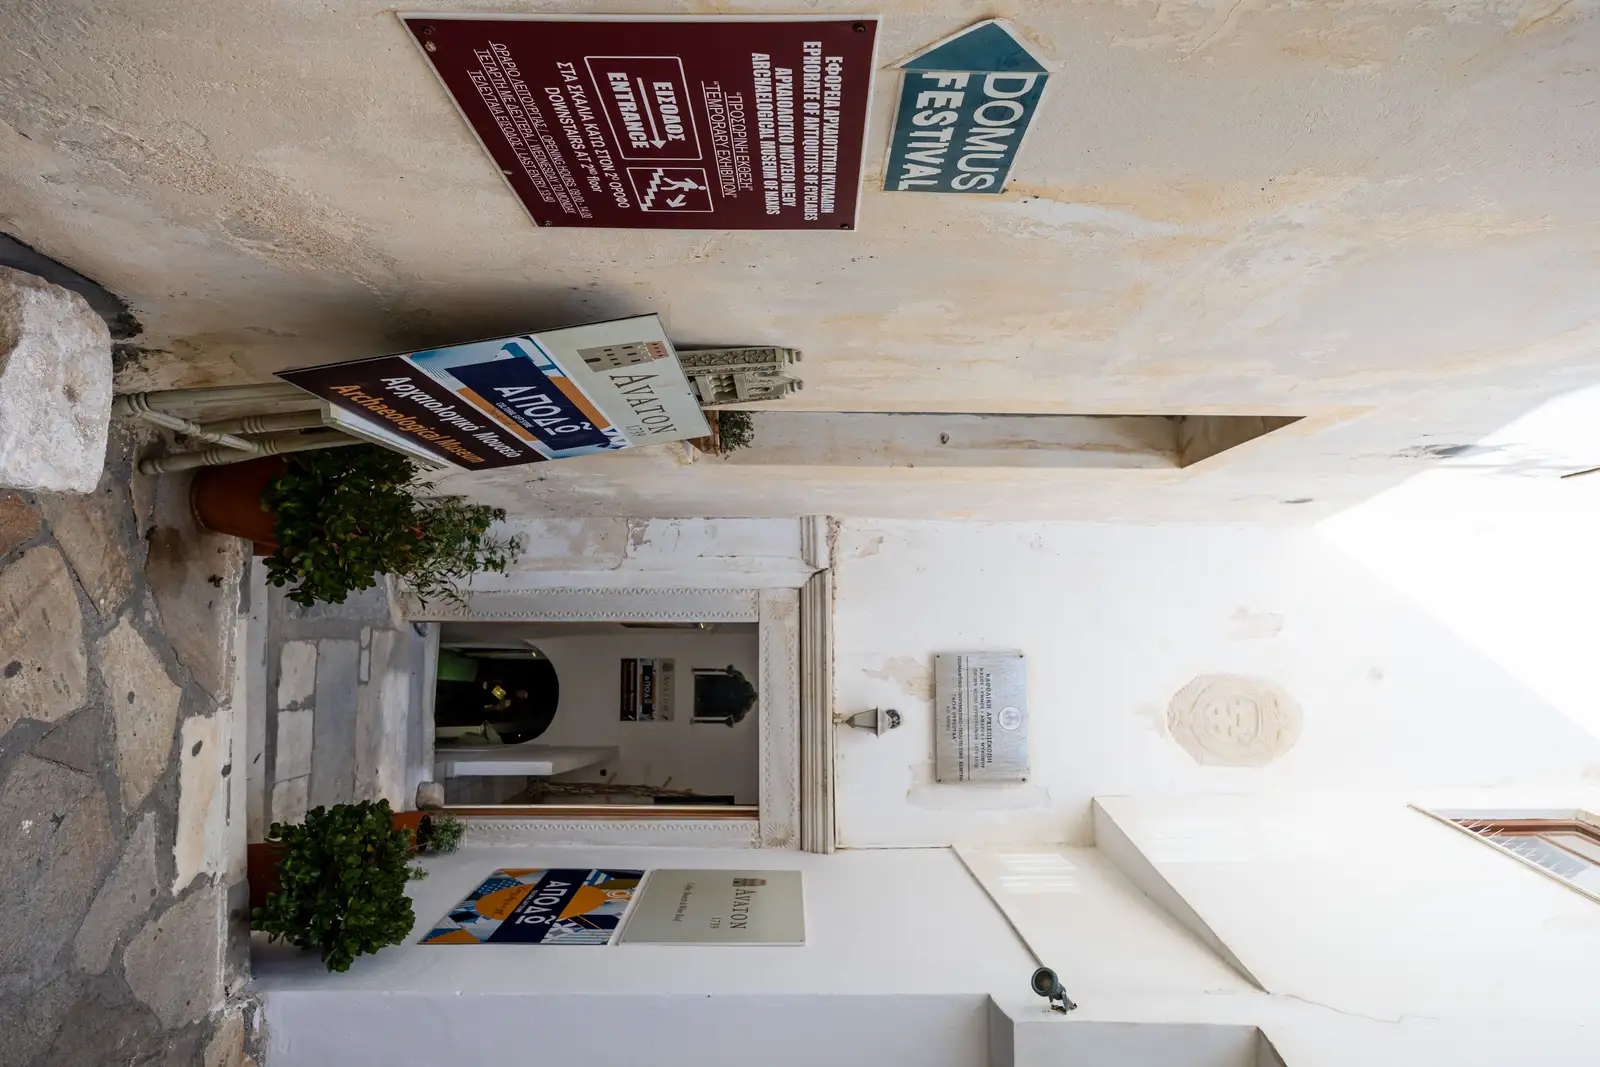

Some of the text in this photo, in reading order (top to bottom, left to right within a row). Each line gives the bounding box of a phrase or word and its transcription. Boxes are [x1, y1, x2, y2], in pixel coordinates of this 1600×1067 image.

[476, 49, 509, 89] ΤΕΤΑΡΤΗ
[556, 61, 577, 83] ΣΤΑ
[470, 70, 504, 115] ΤΕΛΕΥΤΑΙΑ
[500, 90, 517, 103] ΜΕ
[566, 84, 594, 121] ΣΚΑΛΙΑ
[607, 72, 650, 149] ENTRANCE
[652, 81, 686, 141] ΕΙΣΟΔΟΣ
[492, 43, 521, 77] ΩΡΑΡΙΟ
[511, 79, 547, 128] ΛΕΙΤΟΥΡΓΙΑΣ
[542, 135, 566, 165] OPENING
[558, 165, 576, 187] HOURS
[569, 188, 585, 202] 09:00
[580, 206, 593, 219] 14:00
[496, 116, 523, 147] ΕΙΣΟΔΟΣ
[507, 104, 535, 138] ΔΕΥΤΕΡΑ
[544, 87, 586, 150] DOWNSTAIRS
[573, 151, 591, 163] AT
[586, 176, 603, 193] floor
[585, 123, 605, 148] ΚΑΤΩ
[751, 52, 780, 215] ARCHAELOGICAL MUSEUM OF NAXOS
[774, 67, 796, 207] ΑΡΧΑΙΟΛΟΓΙΚΟ ΜΟΥΣΕΙΟ ΝΑΞΟΥ
[802, 41, 821, 221] EPHORATE OF ANTIQUITIES OF CYCLADES
[820, 56, 843, 213] ΕΦΟΡΕΙΑ ΑΡΧΑΙΟΤΗΤΩΝ ΚΥΚΛΑΔΩΝ
[898, 71, 971, 191] FESTIVAL
[950, 73, 1038, 190] DOMUS
[518, 152, 537, 169] LAST
[527, 169, 548, 189] ENTRY
[529, 144, 558, 183] WEDNESDAY
[595, 149, 615, 171] ΣΤΟΝ
[551, 184, 564, 192] TO
[556, 192, 576, 214] MONDAY
[608, 181, 630, 208] ΟΡΟΦΟ
[329, 384, 451, 440] Archaeological
[432, 439, 486, 463] Museum
[380, 376, 485, 432] Αρχαιολογικό
[472, 431, 523, 458] Μουσείο
[608, 374, 677, 435] AVATON
[626, 424, 643, 437] 1739
[709, 917, 722, 929] 1739
[729, 889, 757, 929] AVATON
